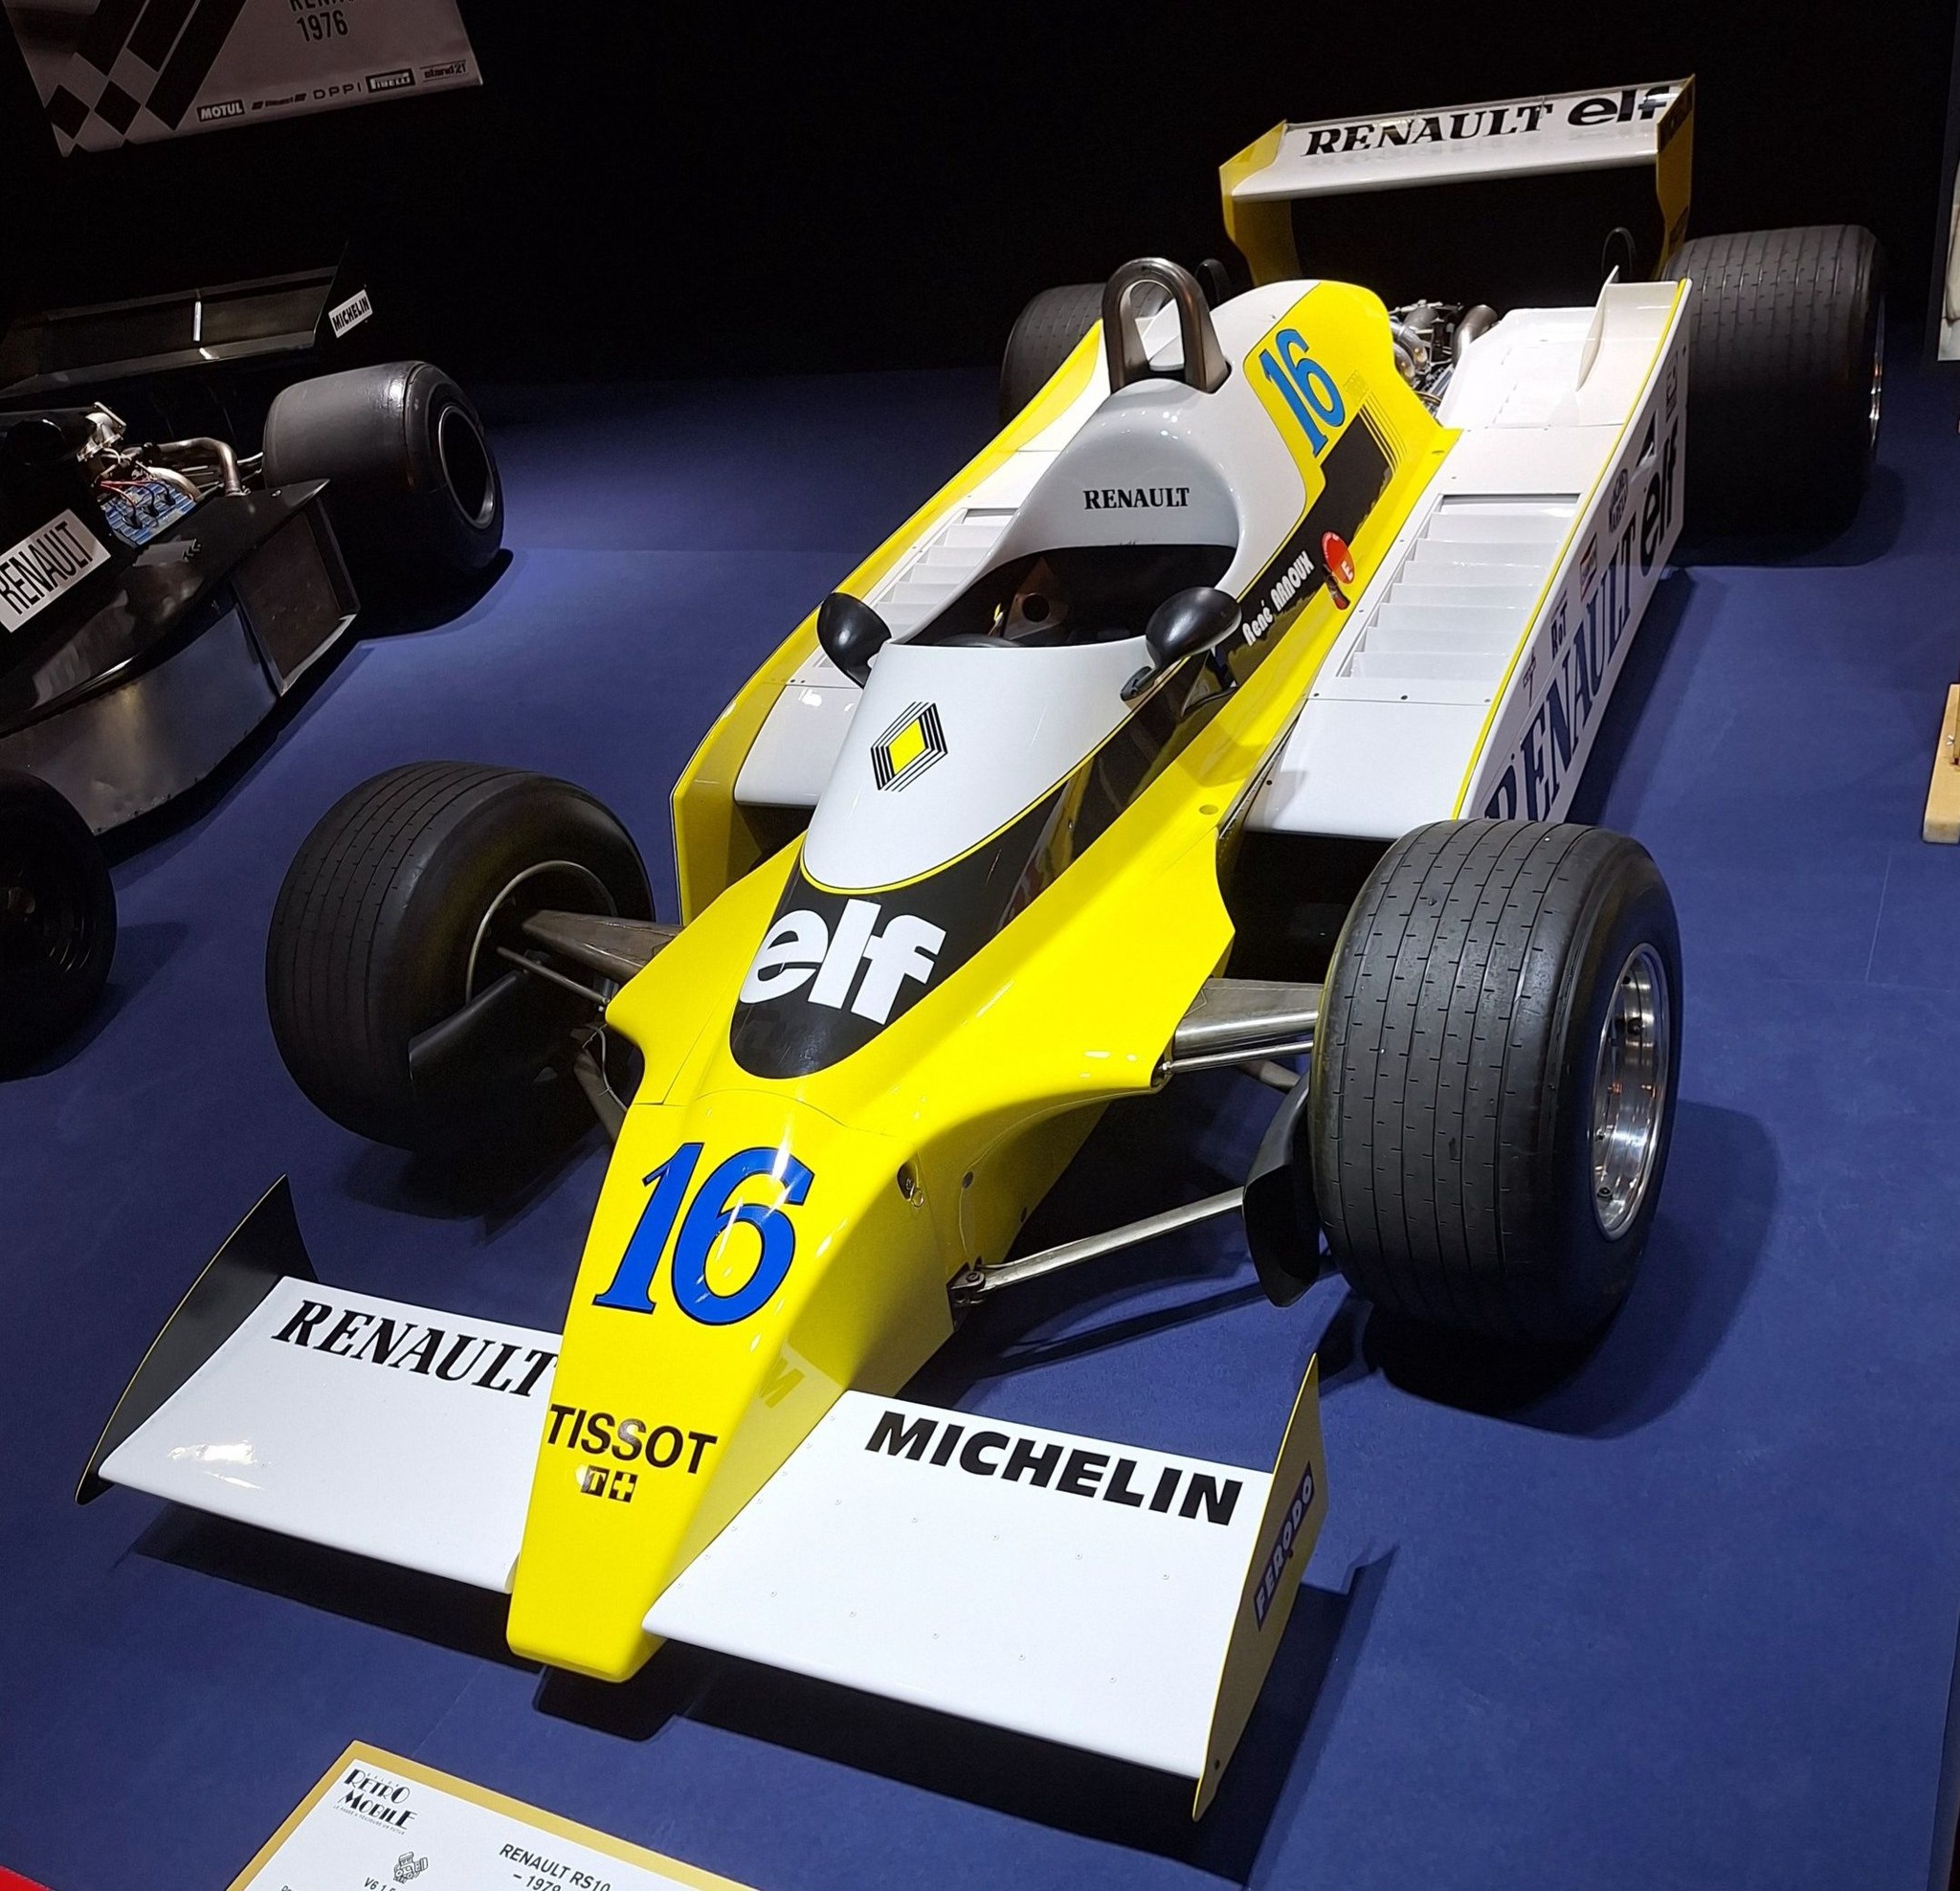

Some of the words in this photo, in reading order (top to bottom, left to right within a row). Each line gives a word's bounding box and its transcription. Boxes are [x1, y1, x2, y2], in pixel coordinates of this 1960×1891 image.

[297, 10, 348, 41] 1976
[200, 101, 243, 120] MOTUL
[313, 81, 362, 100] DPPI
[1301, 103, 1552, 157] RENAULT
[1568, 86, 1671, 126] elf
[332, 296, 370, 332] MICHELIN
[1258, 328, 1345, 458] 16
[1083, 487, 1190, 510] RENAULT
[0, 521, 93, 614] RENAULT
[1484, 511, 1637, 822] RENAULT
[1639, 414, 1679, 577] elf
[740, 898, 947, 1025] elf
[591, 1142, 815, 1325] 16
[272, 1300, 559, 1397] RENAULT
[546, 1403, 718, 1475] TISSOT
[864, 1411, 1243, 1526] MICHELIN
[1256, 1475, 1312, 1621] FERODO
[338, 1790, 417, 1830] MOBILE
[365, 1877, 384, 1890] V6
[499, 1843, 571, 1879] RENAULT
[569, 1871, 611, 1891] RS10
